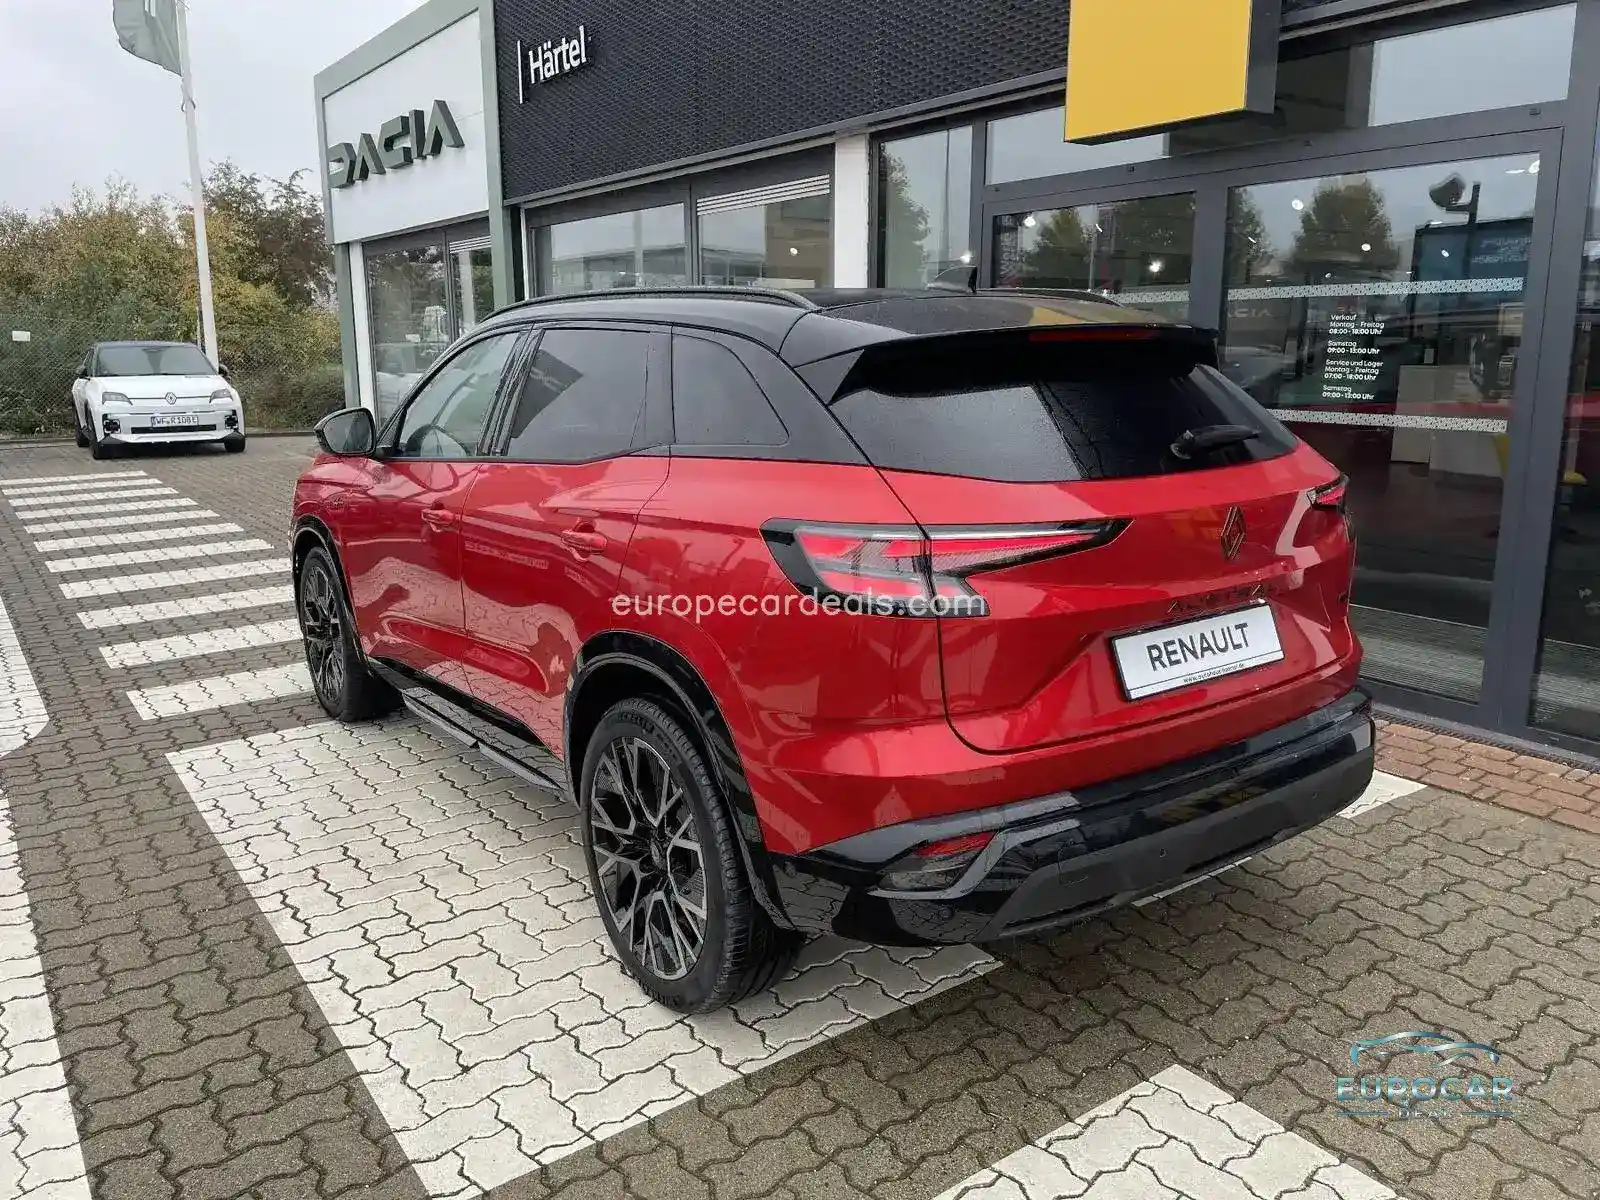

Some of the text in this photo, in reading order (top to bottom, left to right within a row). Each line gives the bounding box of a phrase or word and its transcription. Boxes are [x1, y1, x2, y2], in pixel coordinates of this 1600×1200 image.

[528, 25, 586, 84] Härtel
[328, 99, 465, 188] DACIA
[1146, 622, 1248, 672] RENAULT
